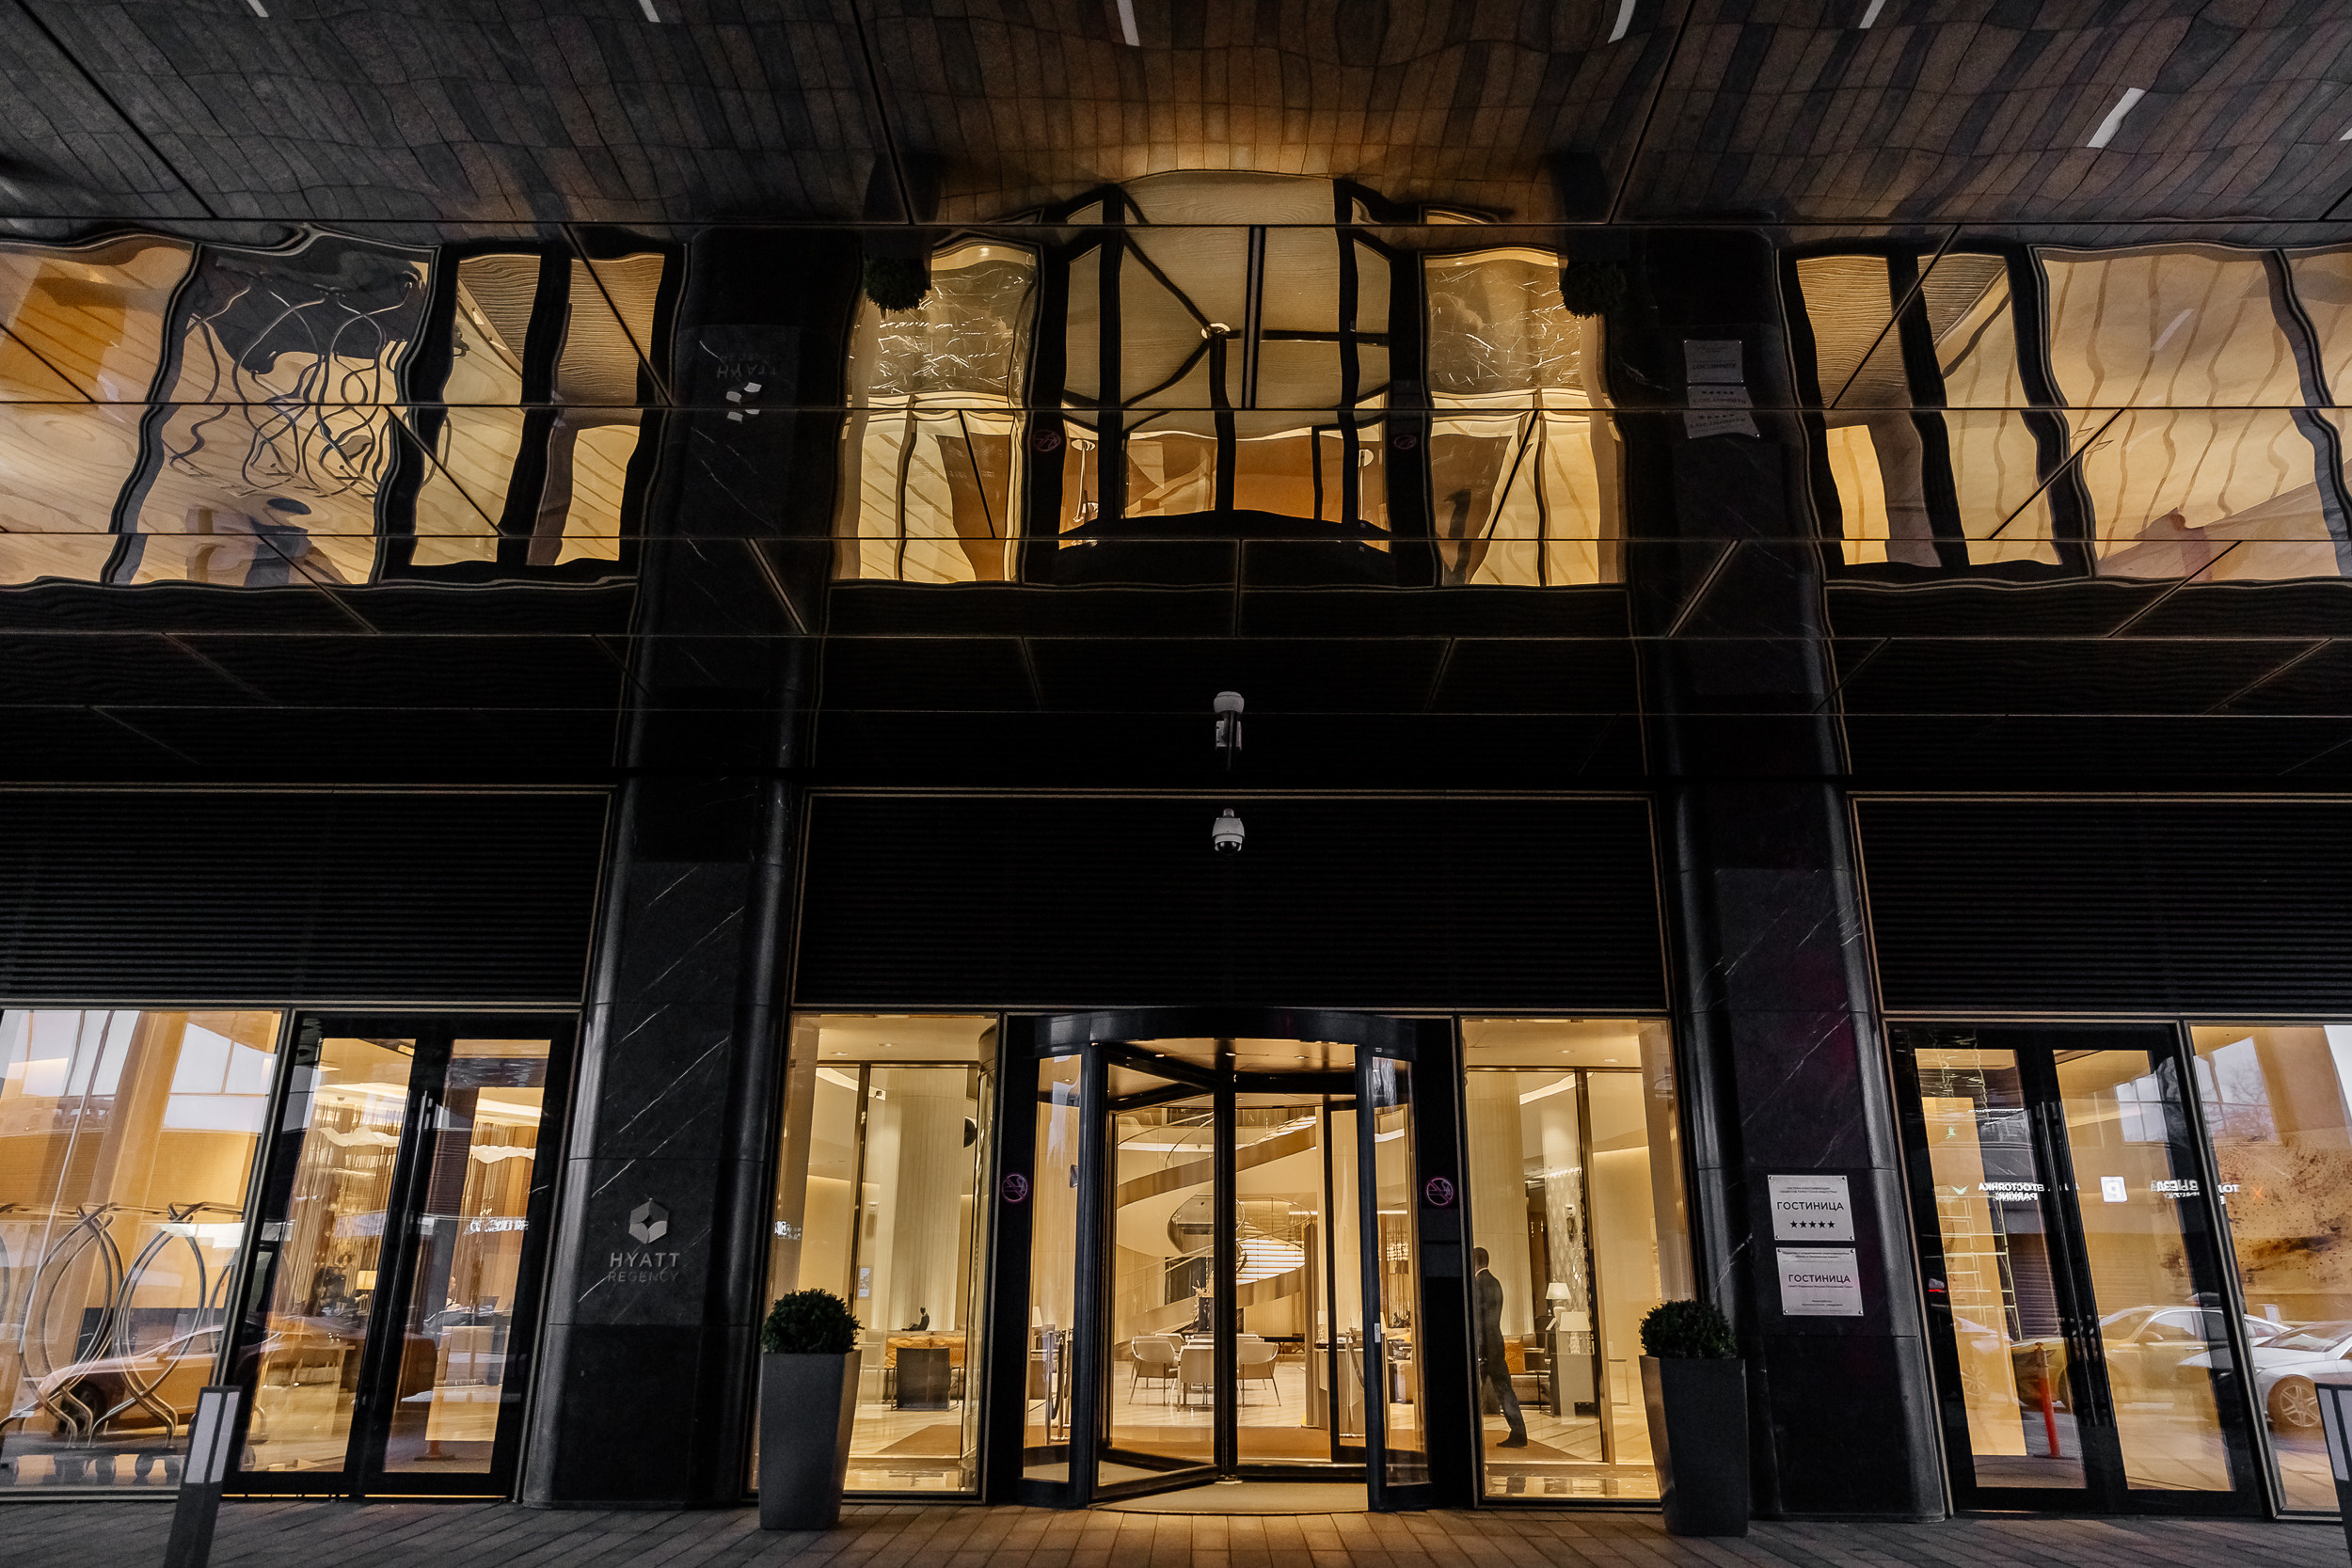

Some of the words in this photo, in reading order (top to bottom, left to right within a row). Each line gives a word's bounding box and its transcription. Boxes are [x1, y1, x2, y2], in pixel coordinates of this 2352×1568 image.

[1777, 1201, 1844, 1212] ГОСТИНИЦА
[610, 1252, 680, 1267] HYATT
[607, 1271, 679, 1282] REGENCY
[1788, 1274, 1851, 1284] ГОСТИНИЦА
